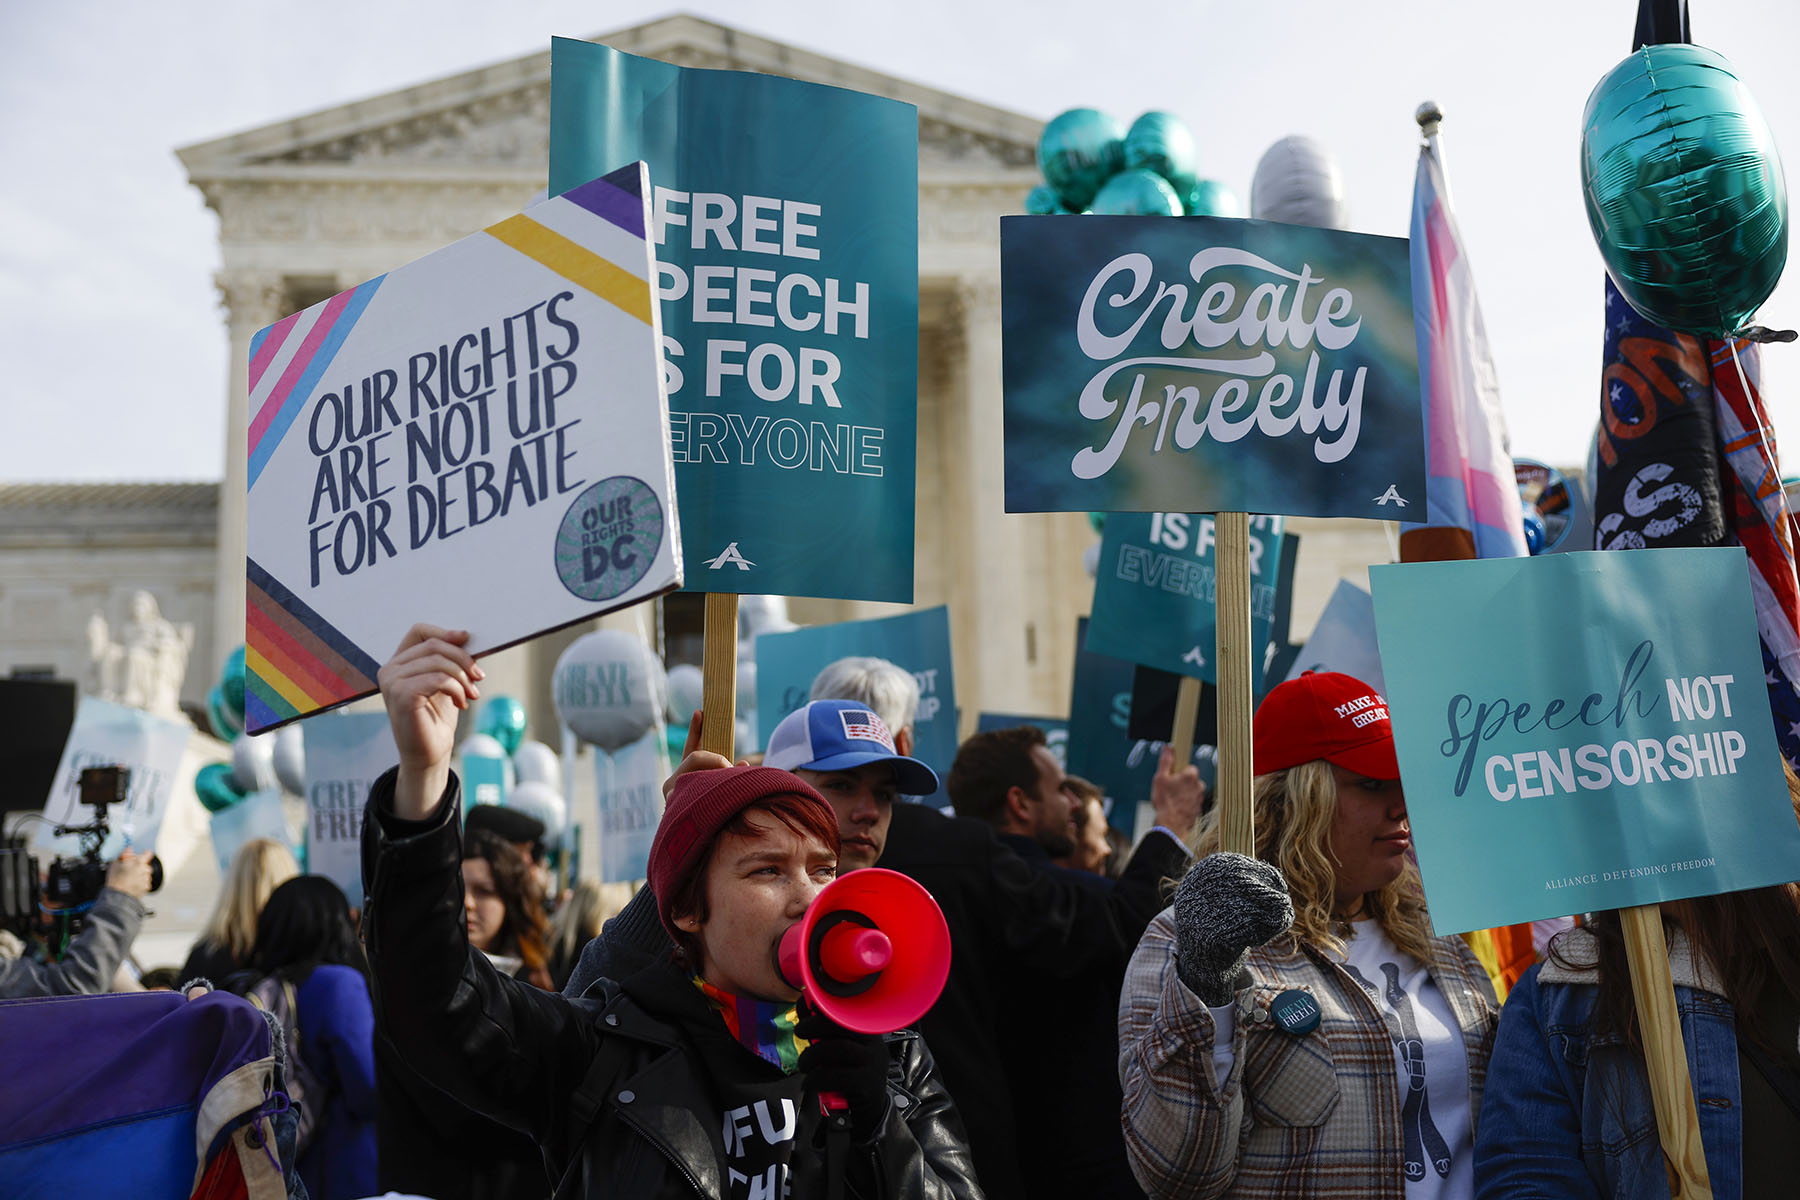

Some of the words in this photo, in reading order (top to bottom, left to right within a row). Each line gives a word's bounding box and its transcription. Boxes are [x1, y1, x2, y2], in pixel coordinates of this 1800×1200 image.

[653, 185, 822, 261] FREE
[656, 261, 870, 339] PEECH
[1076, 246, 1362, 361] Create
[308, 368, 402, 457] OUR
[408, 291, 580, 418] RIGHTS
[705, 338, 842, 408] FOR
[308, 431, 397, 525] ARE
[407, 389, 496, 484] NOT
[507, 360, 577, 440] UP
[669, 411, 885, 478] ERYONE
[1071, 349, 1368, 480] Freely
[310, 500, 398, 588] FOR
[408, 418, 587, 551] DEBATE
[581, 495, 633, 529] OUR
[581, 518, 635, 548] RIGHTS
[582, 534, 638, 584] DC
[1149, 513, 1191, 551] IS
[1195, 517, 1266, 576] FR
[1334, 695, 1375, 719] MAKE
[1352, 708, 1389, 729] GREAT
[1440, 639, 1660, 798] speech
[1665, 674, 1734, 722] NOT
[312, 779, 373, 809] CRE
[1485, 730, 1746, 802] CENSORSHIP
[315, 810, 363, 842] FRE
[1544, 873, 1599, 890] ALLIANCE
[1603, 864, 1669, 882] DEFENDING
[1671, 857, 1717, 873] FREEDOM
[1277, 995, 1310, 1019] CREATE
[1283, 1001, 1316, 1027] FREELY
